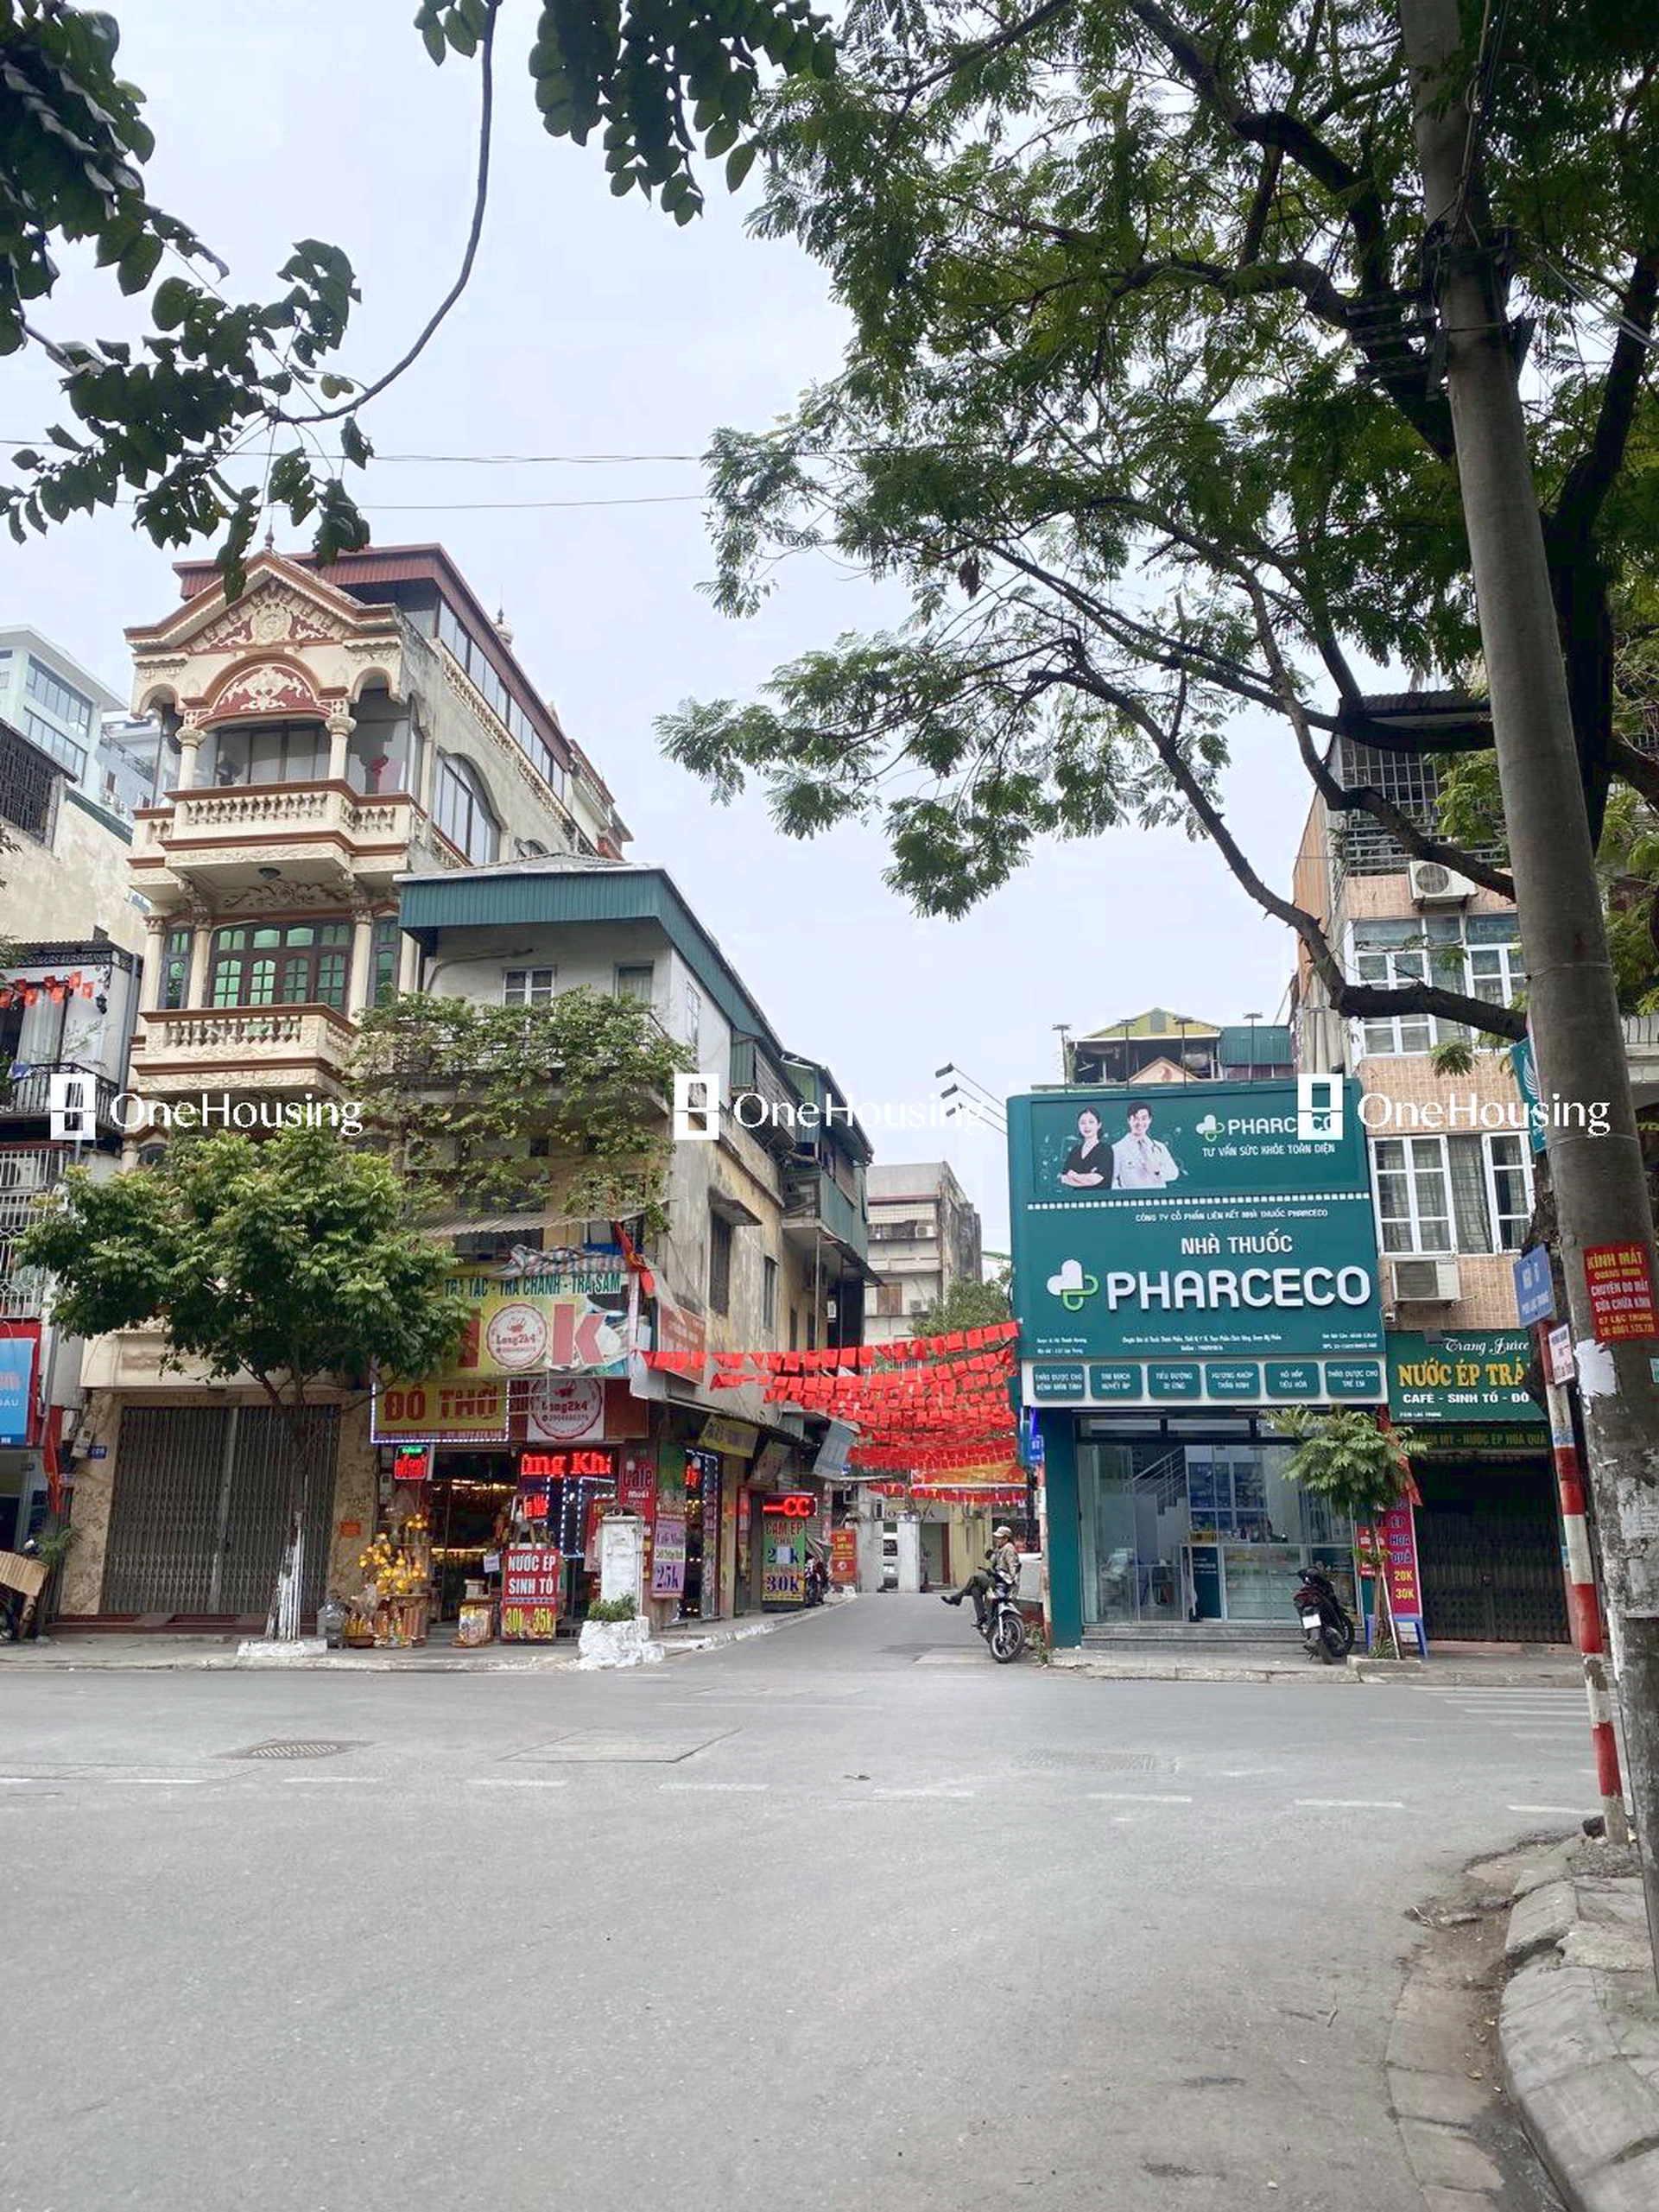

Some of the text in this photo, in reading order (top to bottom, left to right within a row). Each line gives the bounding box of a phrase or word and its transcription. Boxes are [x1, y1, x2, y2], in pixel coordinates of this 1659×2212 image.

[1228, 1116, 1334, 1135] PHARCCO
[1181, 1228, 1293, 1254] NHÀ THUỐC
[1106, 1266, 1371, 1310] PHARCECO
[1397, 1357, 1452, 1387] NƯỚC
[1455, 1359, 1479, 1387] ÉP
[1485, 1357, 1529, 1387] TRÁ
[1447, 1393, 1478, 1404] SINH
[1482, 1390, 1498, 1404] TỐ
[508, 1553, 540, 1572] NƯỚC
[768, 1548, 799, 1564] 2k
[508, 1573, 554, 1595] SINH TỐ
[1394, 1570, 1414, 1581] 20K
